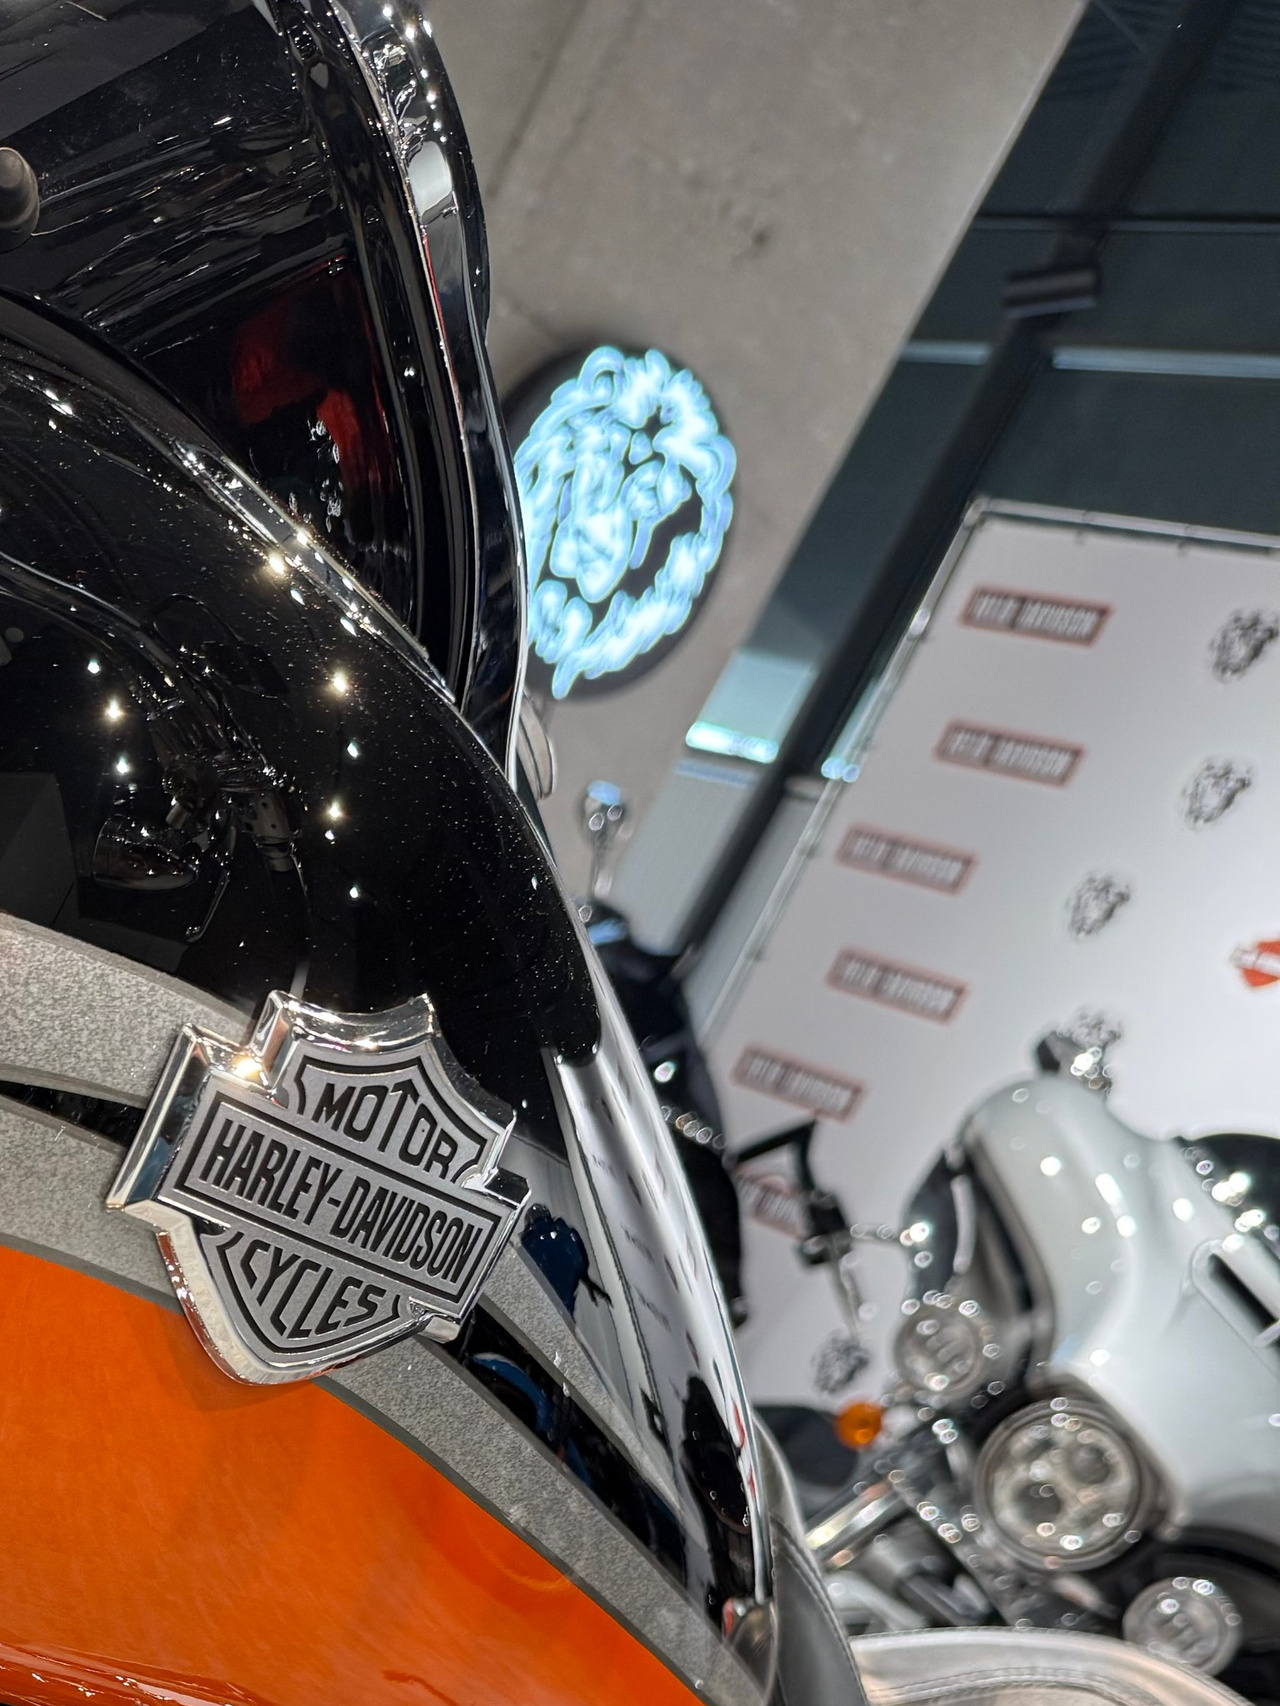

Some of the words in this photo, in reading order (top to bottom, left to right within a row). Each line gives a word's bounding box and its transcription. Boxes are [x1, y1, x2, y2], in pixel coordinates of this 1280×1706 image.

[312, 1079, 458, 1181] MOTOR
[198, 1119, 483, 1283] HARLEY-DAVIDSON
[240, 1238, 387, 1340] CYCLES
